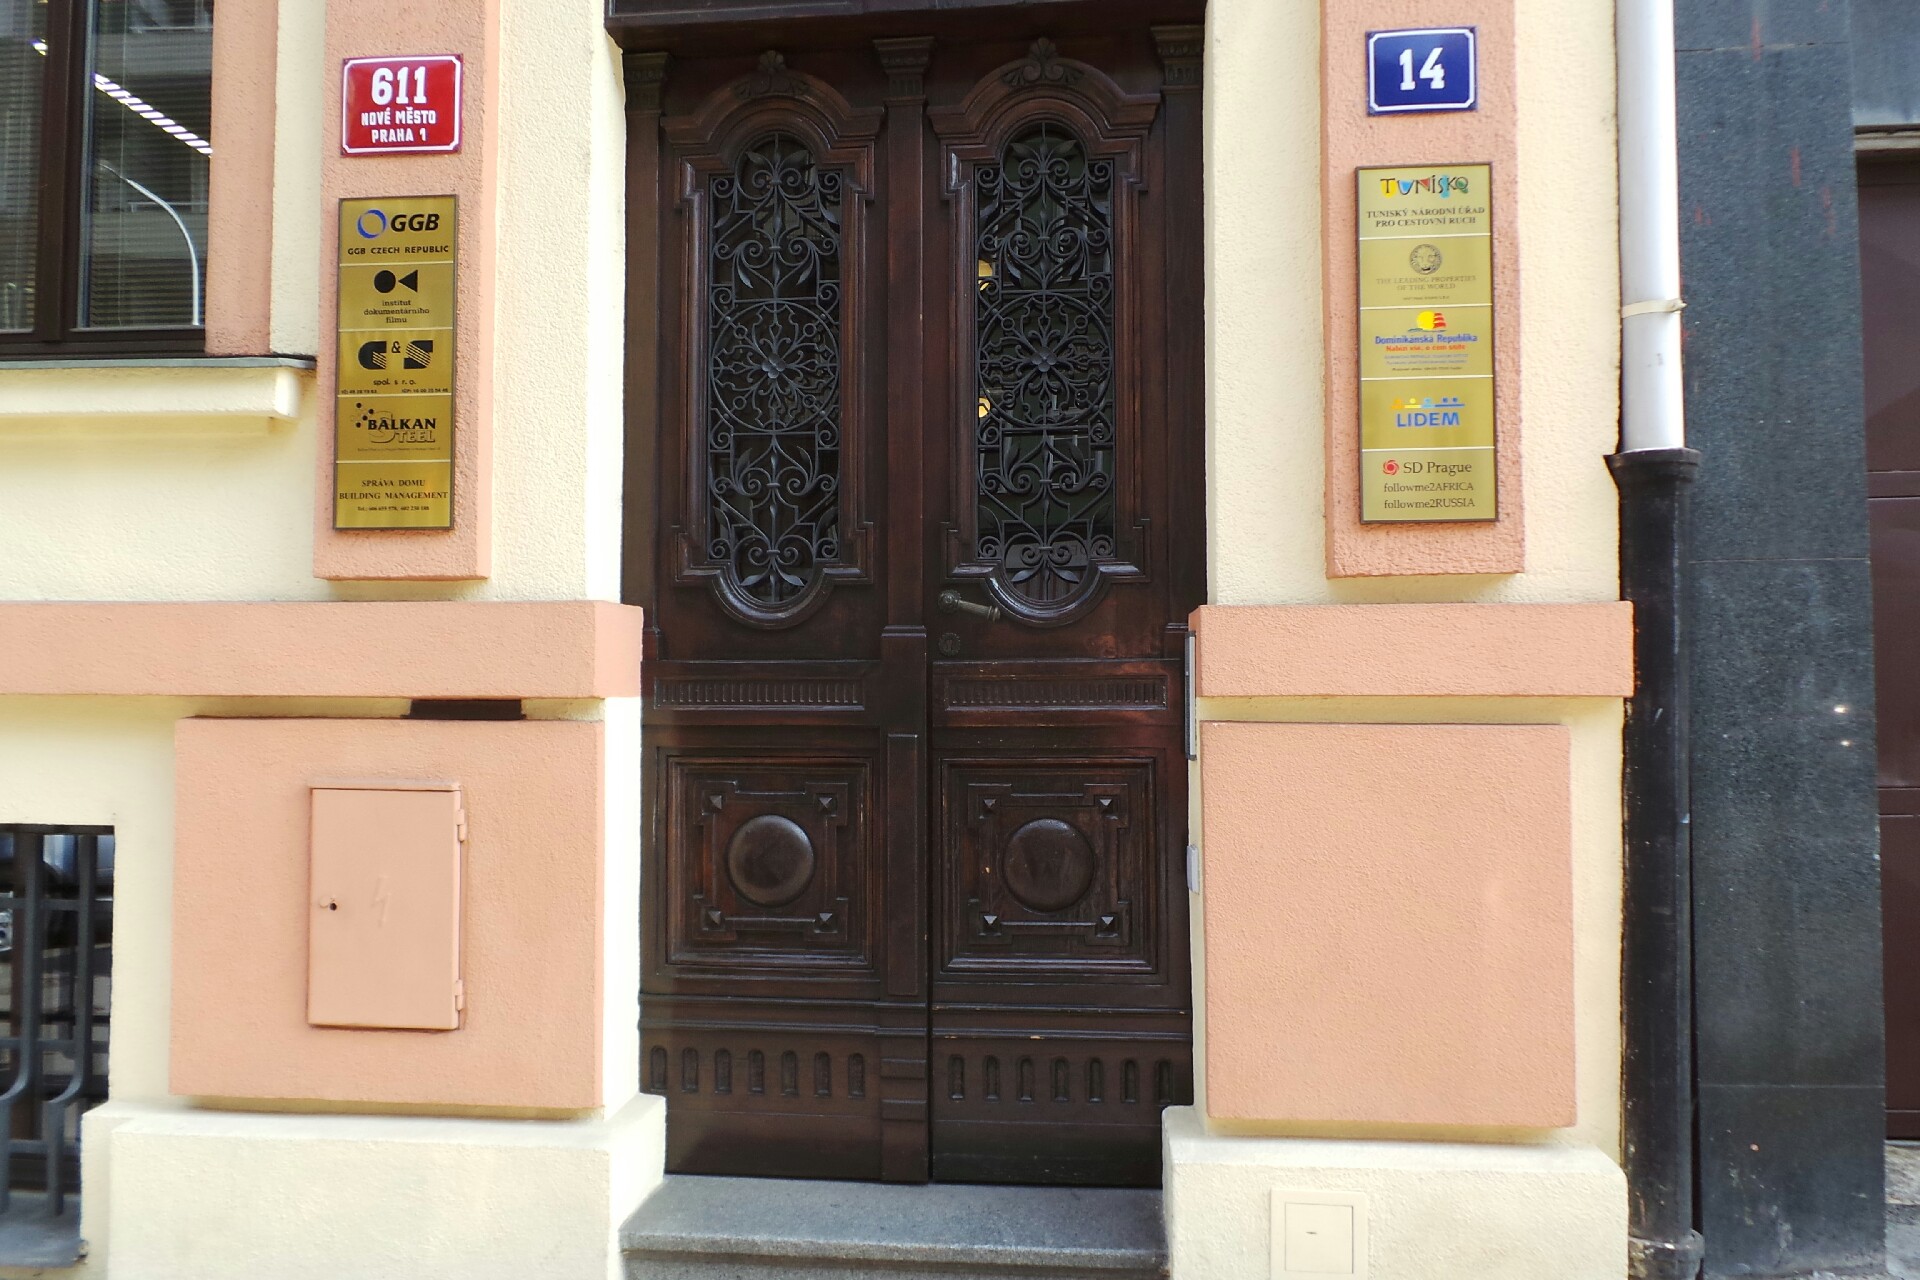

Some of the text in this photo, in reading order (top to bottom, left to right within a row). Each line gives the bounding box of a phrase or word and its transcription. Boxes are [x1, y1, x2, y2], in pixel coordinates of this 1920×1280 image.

[1399, 47, 1445, 90] 14
[371, 66, 427, 105] 611
[361, 106, 437, 126] NOVÉ MĚSTO
[371, 127, 426, 143] PRAHA 1
[1367, 207, 1409, 219] TUNISKÝ
[1412, 205, 1456, 216] NÁRODNÍ
[390, 213, 440, 232] GGB
[1397, 217, 1446, 226] CESTOVNÍ
[1449, 216, 1476, 224] RUCH
[347, 245, 449, 255] GGB CZECH REPUBLIC
[1437, 333, 1478, 343] Republika
[391, 340, 401, 353] &
[403, 339, 434, 369] S
[368, 418, 435, 430] BALKAN
[1397, 412, 1460, 427] LIDEM
[1403, 462, 1472, 476] SD Prague
[362, 478, 394, 487] SPRÁVA
[1384, 482, 1474, 492] followme2AFRICA
[1384, 499, 1475, 509] followme2RUSSIA
